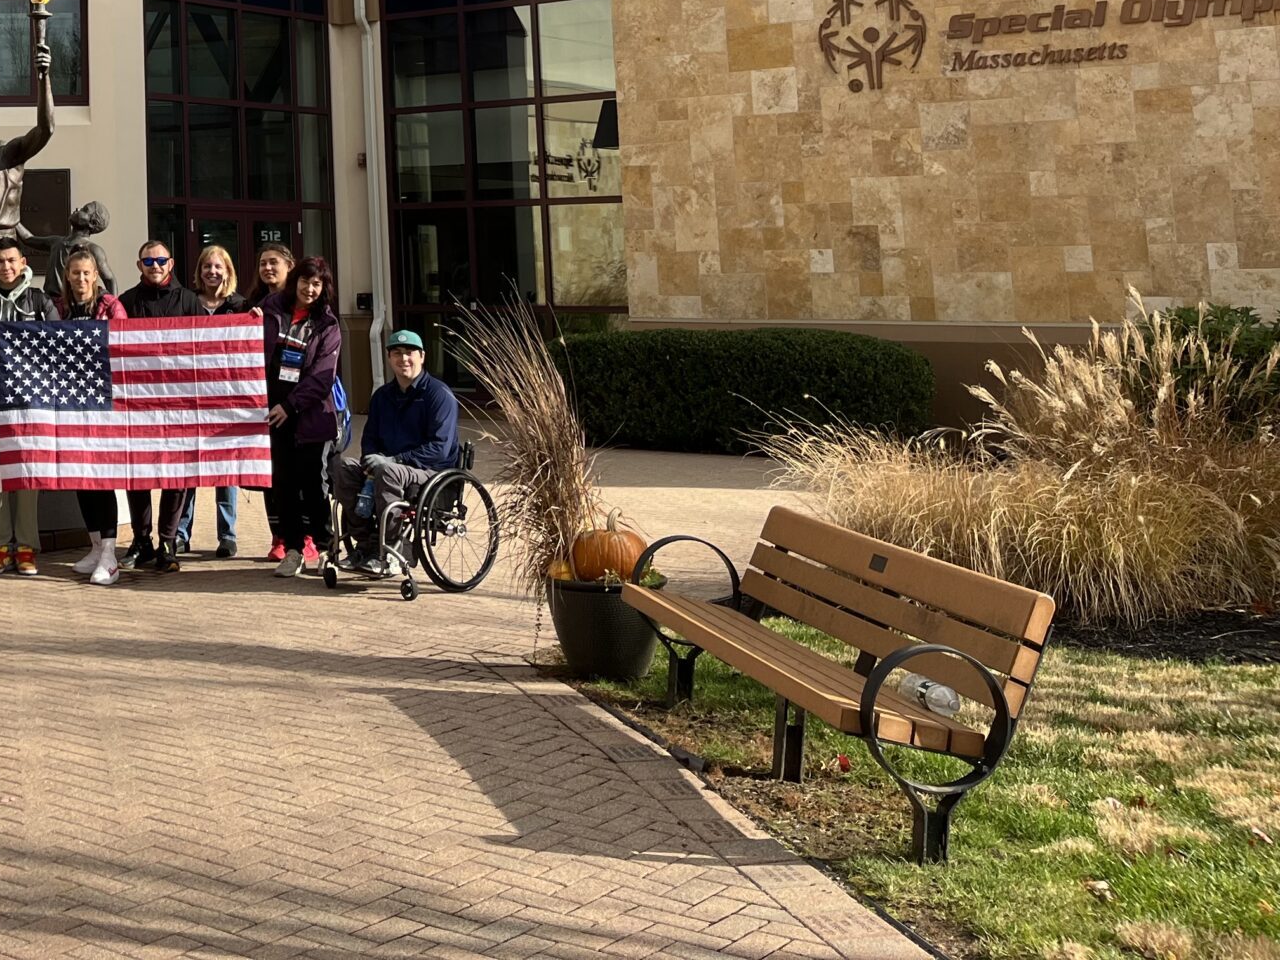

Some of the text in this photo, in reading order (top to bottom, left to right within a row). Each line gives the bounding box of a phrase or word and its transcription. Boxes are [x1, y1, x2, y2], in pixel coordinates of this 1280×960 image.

[946, 0, 1108, 44] Special
[950, 40, 1129, 72] Massachusetts
[260, 230, 281, 242] 512
